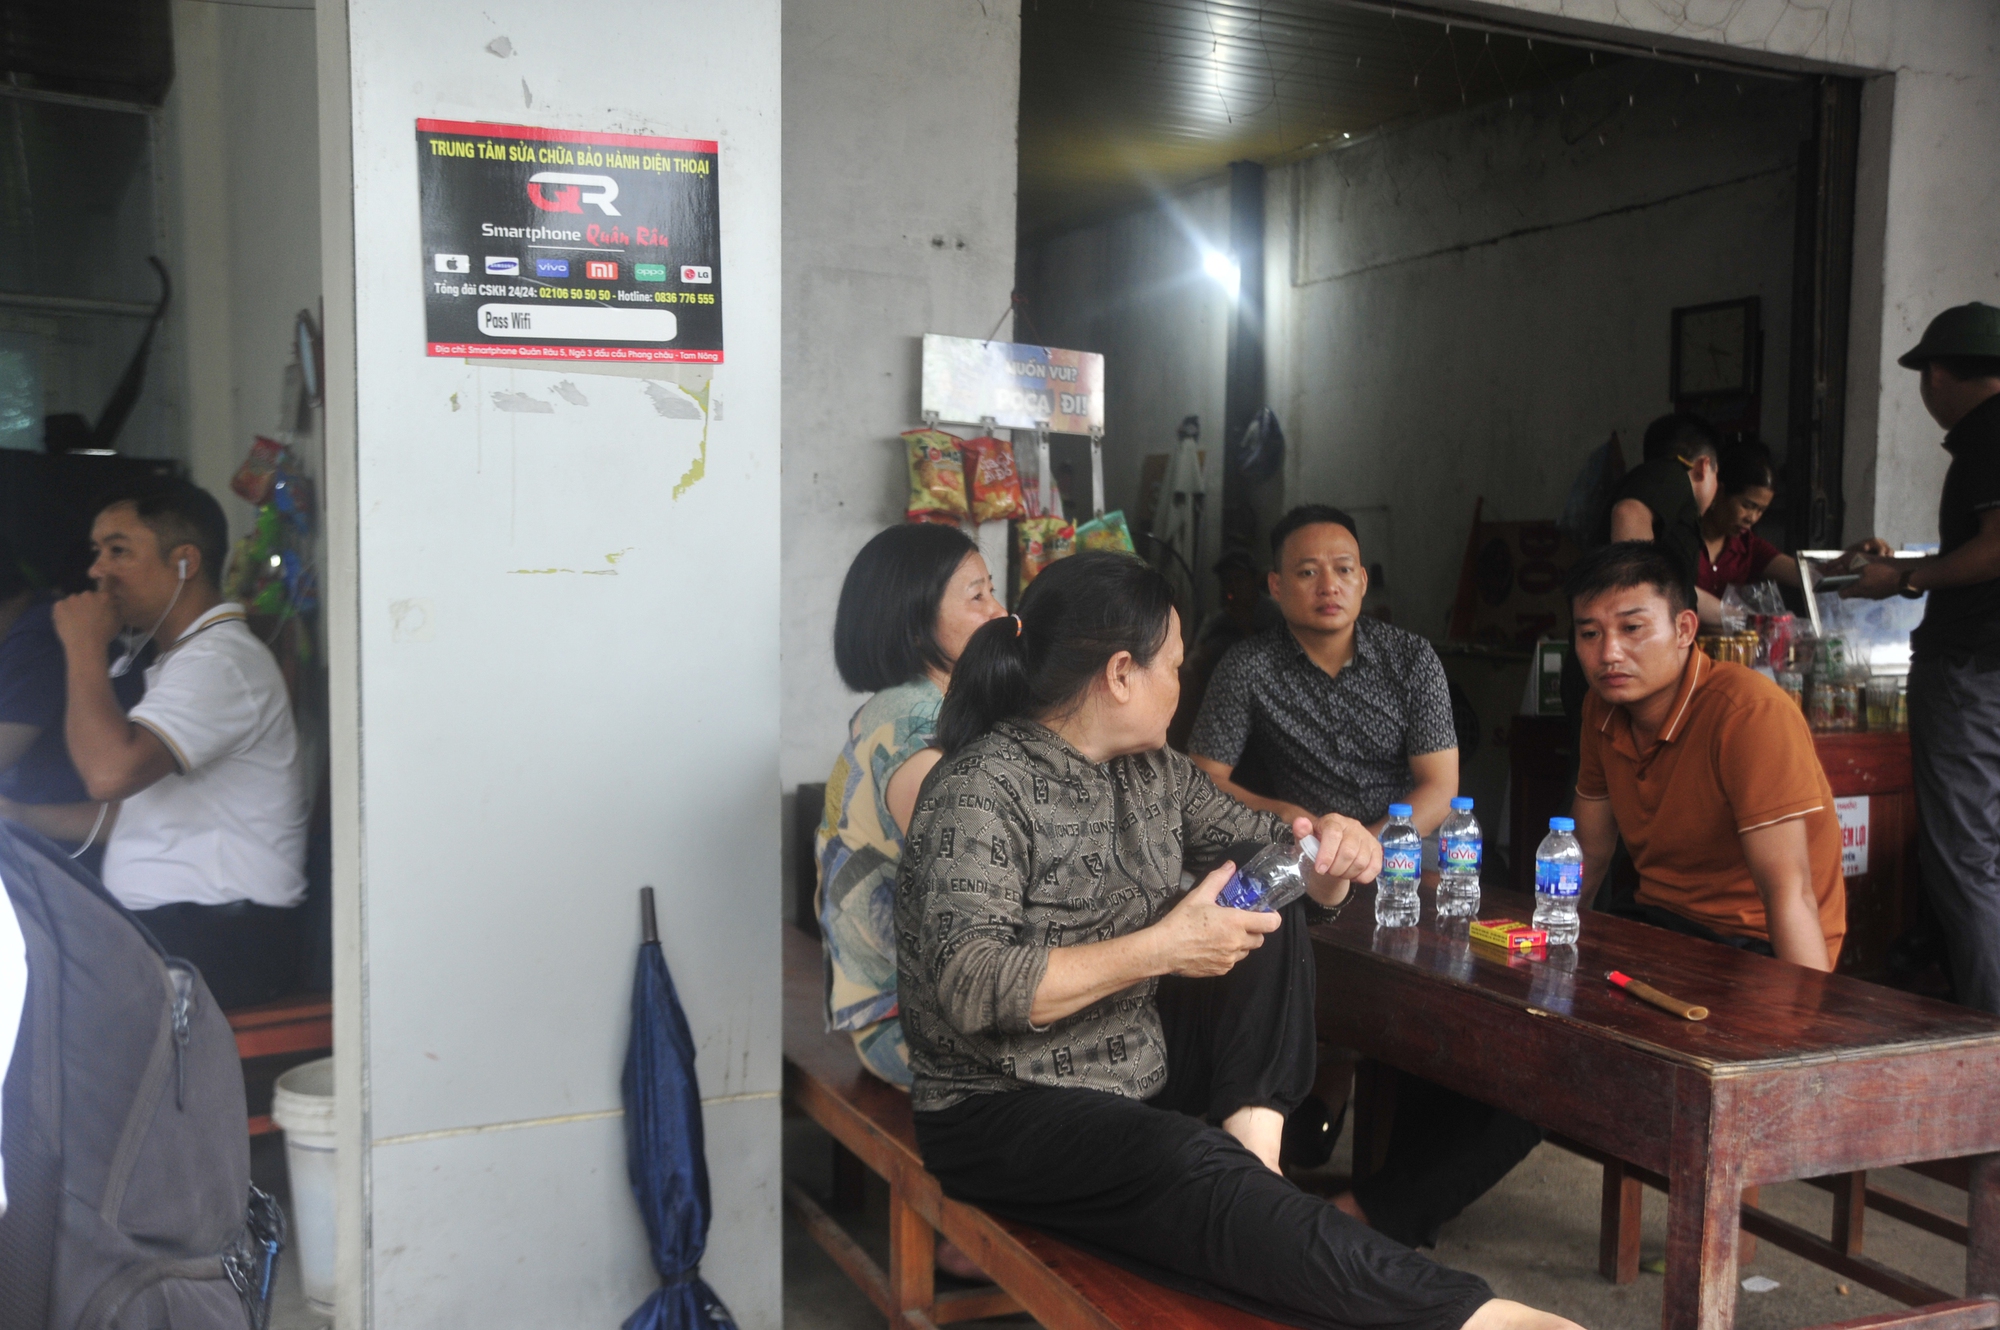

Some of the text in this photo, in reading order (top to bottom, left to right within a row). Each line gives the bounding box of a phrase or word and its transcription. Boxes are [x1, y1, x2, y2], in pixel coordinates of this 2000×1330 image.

[429, 139, 710, 178] TRUNG TÂM SỬA CHỮA BẢO HÀNH ĐIỆN THOẠI
[481, 223, 669, 248] Smartphone Quân Râu
[538, 263, 567, 272] vivo
[697, 271, 709, 279] LG
[434, 280, 459, 297] Tổng
[461, 283, 477, 296] đài
[479, 285, 507, 297] CSKH
[508, 286, 538, 298] 24/24:
[539, 287, 569, 299] 02106
[570, 288, 583, 300] 50
[584, 289, 597, 300] 50
[598, 290, 611, 301] 50
[617, 290, 653, 302] Hotline:
[654, 292, 677, 304] 0836
[679, 293, 695, 304] 776
[697, 294, 715, 305] 555
[485, 312, 531, 330] Pass Wifi
[468, 346, 517, 356] Smartphone
[1060, 392, 1088, 416] ĐI!
